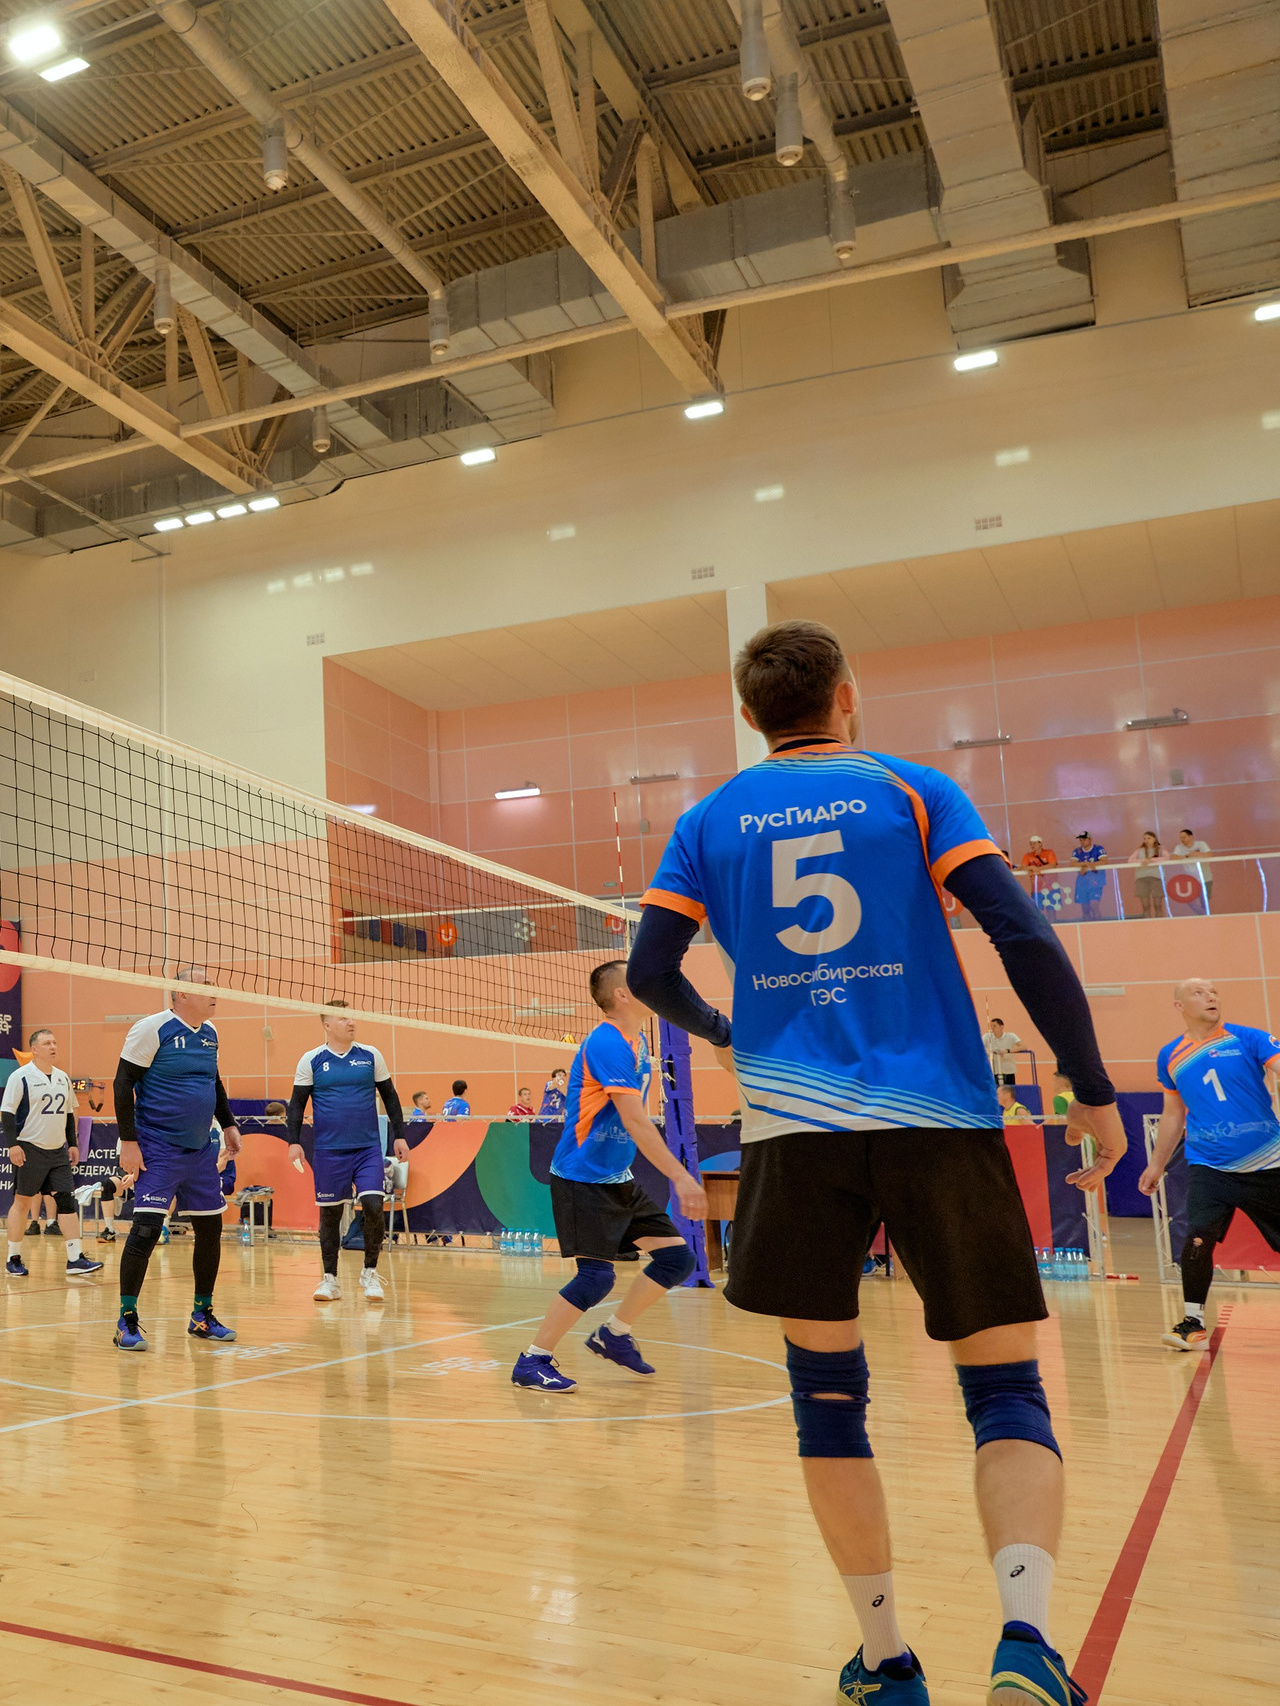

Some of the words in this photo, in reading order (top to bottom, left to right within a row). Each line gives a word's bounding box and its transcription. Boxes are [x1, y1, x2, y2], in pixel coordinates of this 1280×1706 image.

[740, 799, 867, 833] РусГидро
[771, 830, 862, 956] 5
[752, 962, 904, 990] Новосибирская
[810, 987, 847, 1007] ГЭС
[173, 1035, 186, 1049] 11
[322, 1061, 330, 1072] 8
[1202, 1068, 1227, 1102] 1
[41, 1093, 66, 1114] 22
[88, 1149, 117, 1159] АСТЕ
[71, 1165, 119, 1176] ФЕДЕРАЛ
